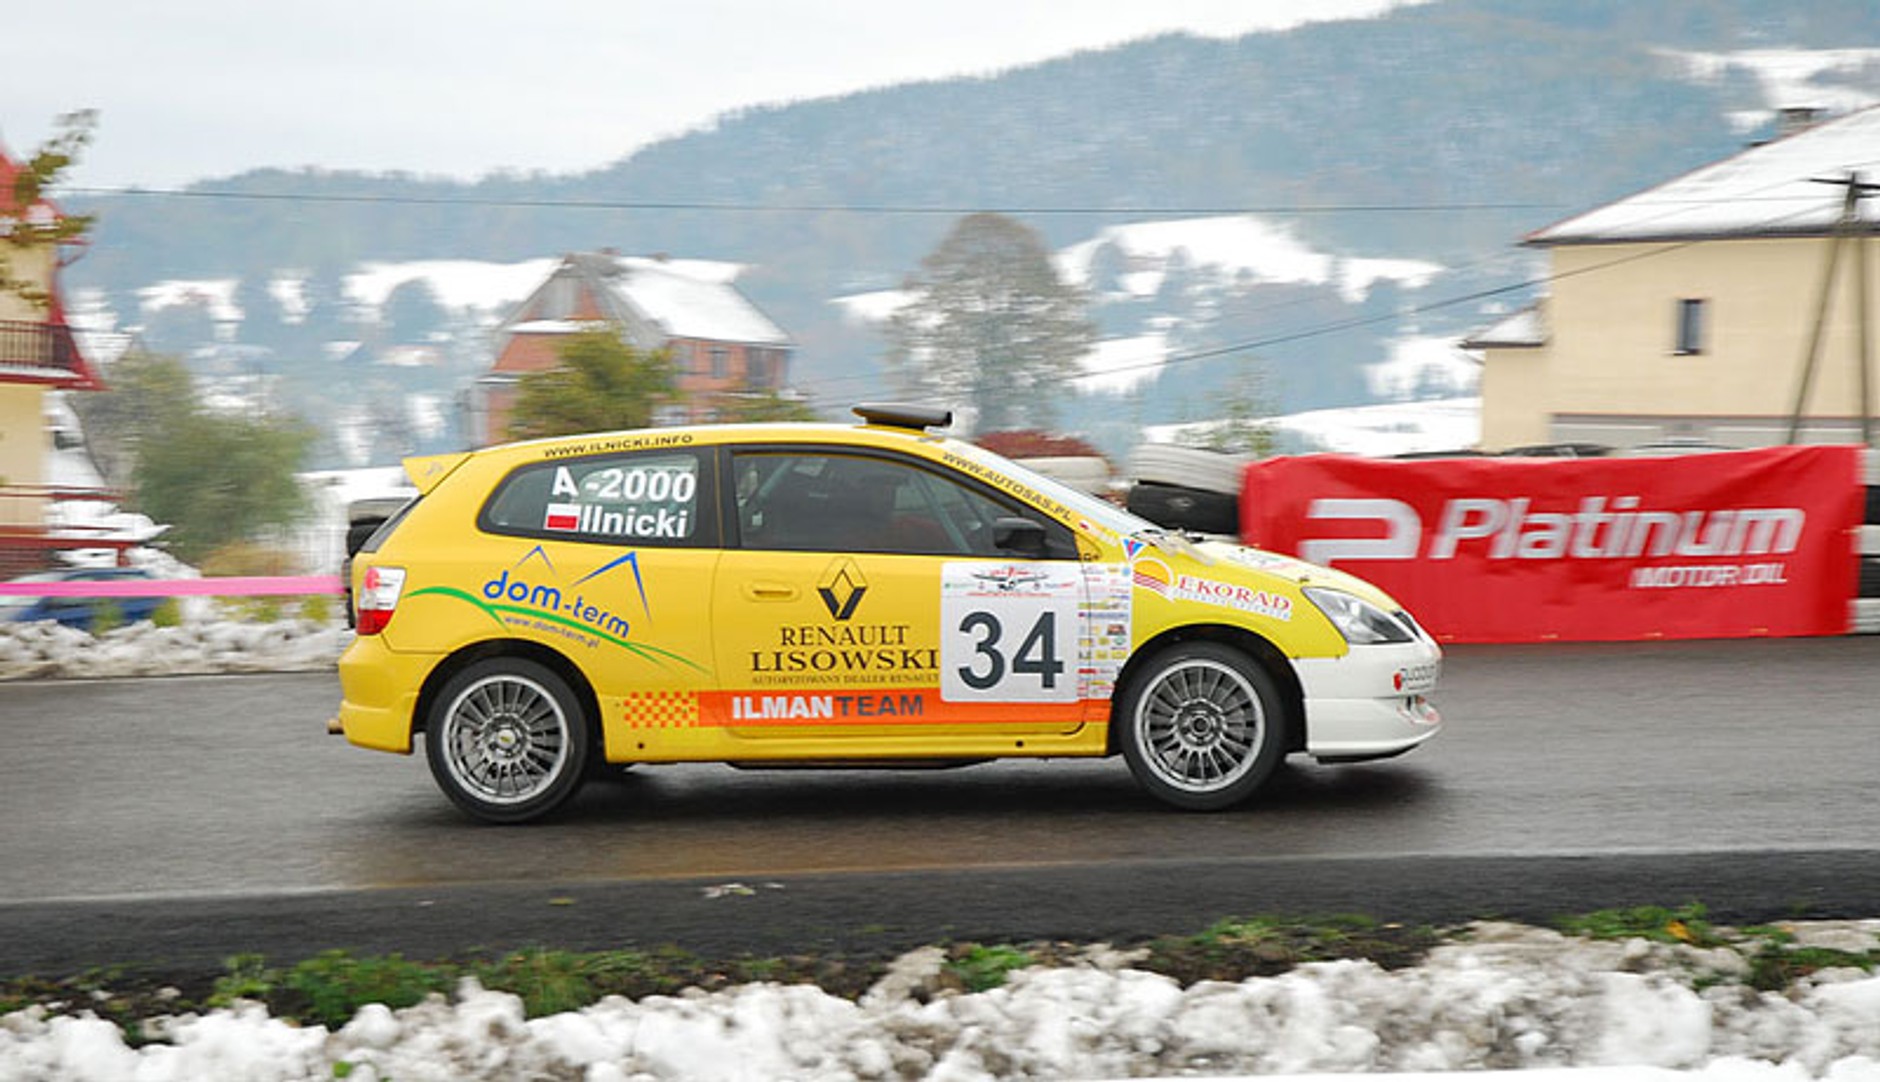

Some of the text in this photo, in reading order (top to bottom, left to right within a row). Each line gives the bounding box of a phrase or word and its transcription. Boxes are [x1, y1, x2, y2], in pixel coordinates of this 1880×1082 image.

[544, 434, 693, 457] WWW.ILNICKI.INFO
[552, 466, 579, 496] A
[943, 452, 1072, 521] WWW.AUTOSAS.PL
[1429, 497, 1804, 559] Platinum
[1630, 565, 1740, 588] MOTOR
[483, 570, 630, 638] dom-term
[1178, 576, 1291, 610] EKORAD
[780, 625, 910, 646] RENAULT
[958, 611, 1064, 690] 34
[751, 649, 940, 672] LISOWSKI
